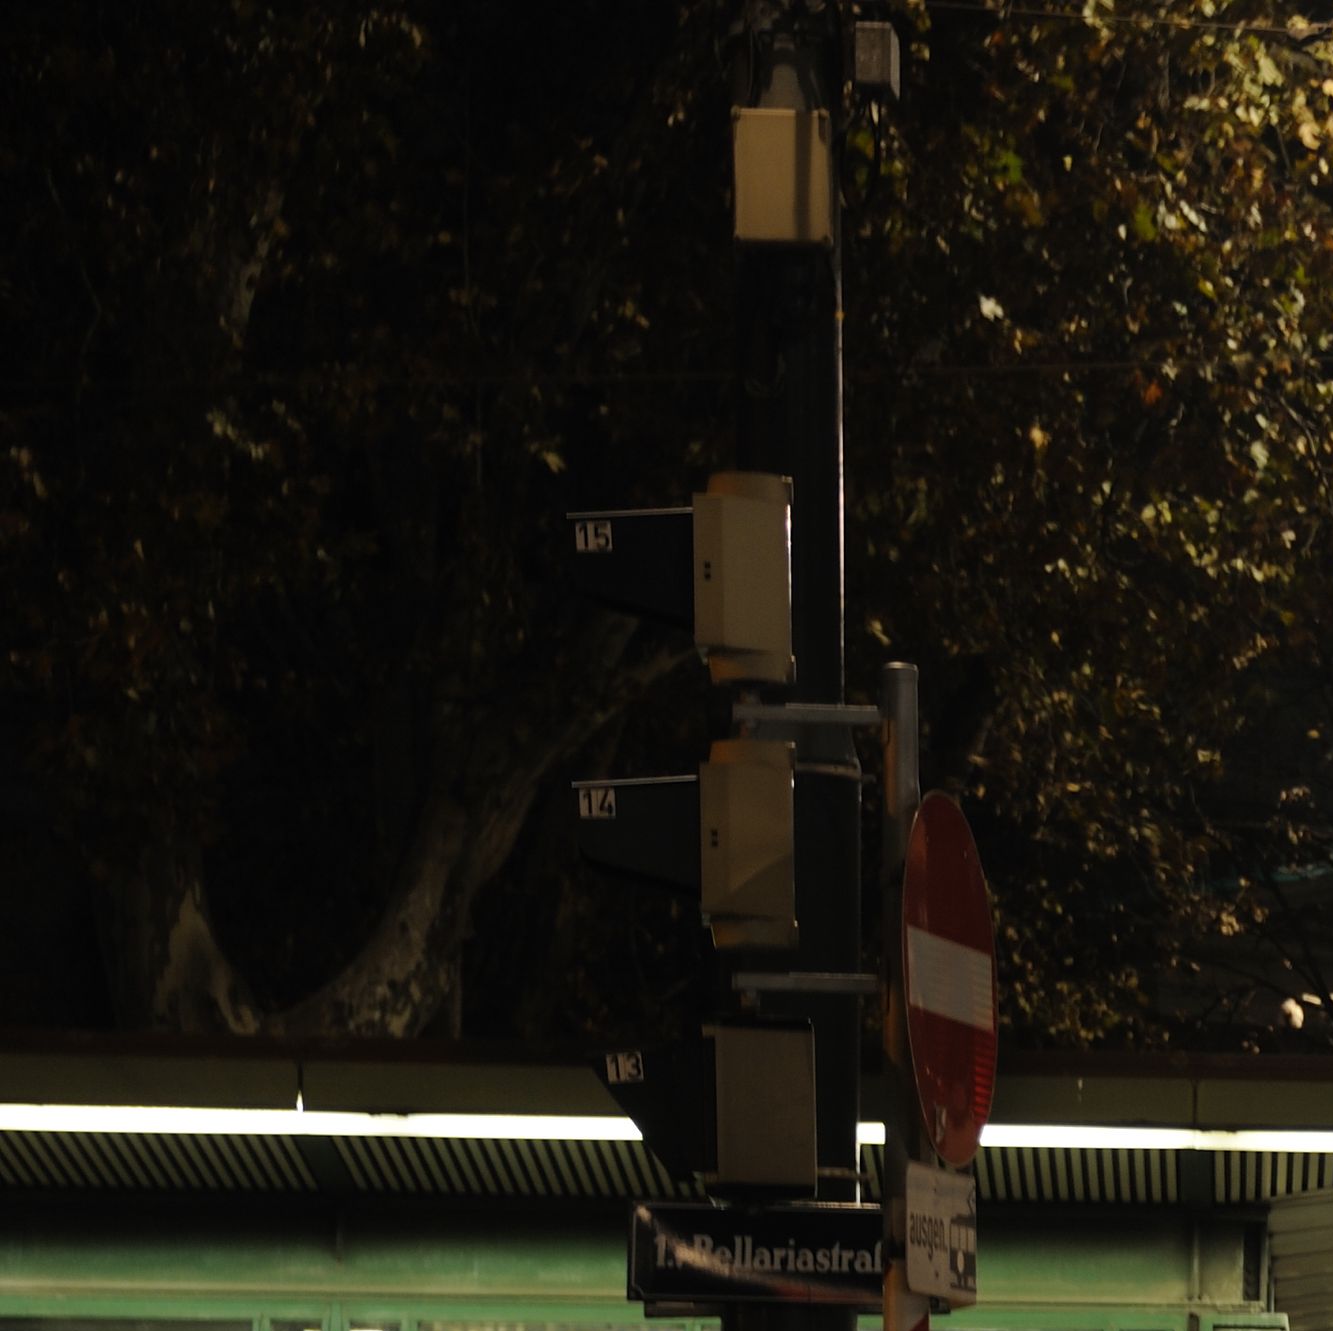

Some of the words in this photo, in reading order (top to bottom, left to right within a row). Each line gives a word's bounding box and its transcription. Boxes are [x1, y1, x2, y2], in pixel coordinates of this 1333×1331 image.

[578, 522, 610, 549] 15
[582, 787, 614, 815] 14
[609, 1052, 642, 1081] 13
[908, 1211, 948, 1261] ausgen.
